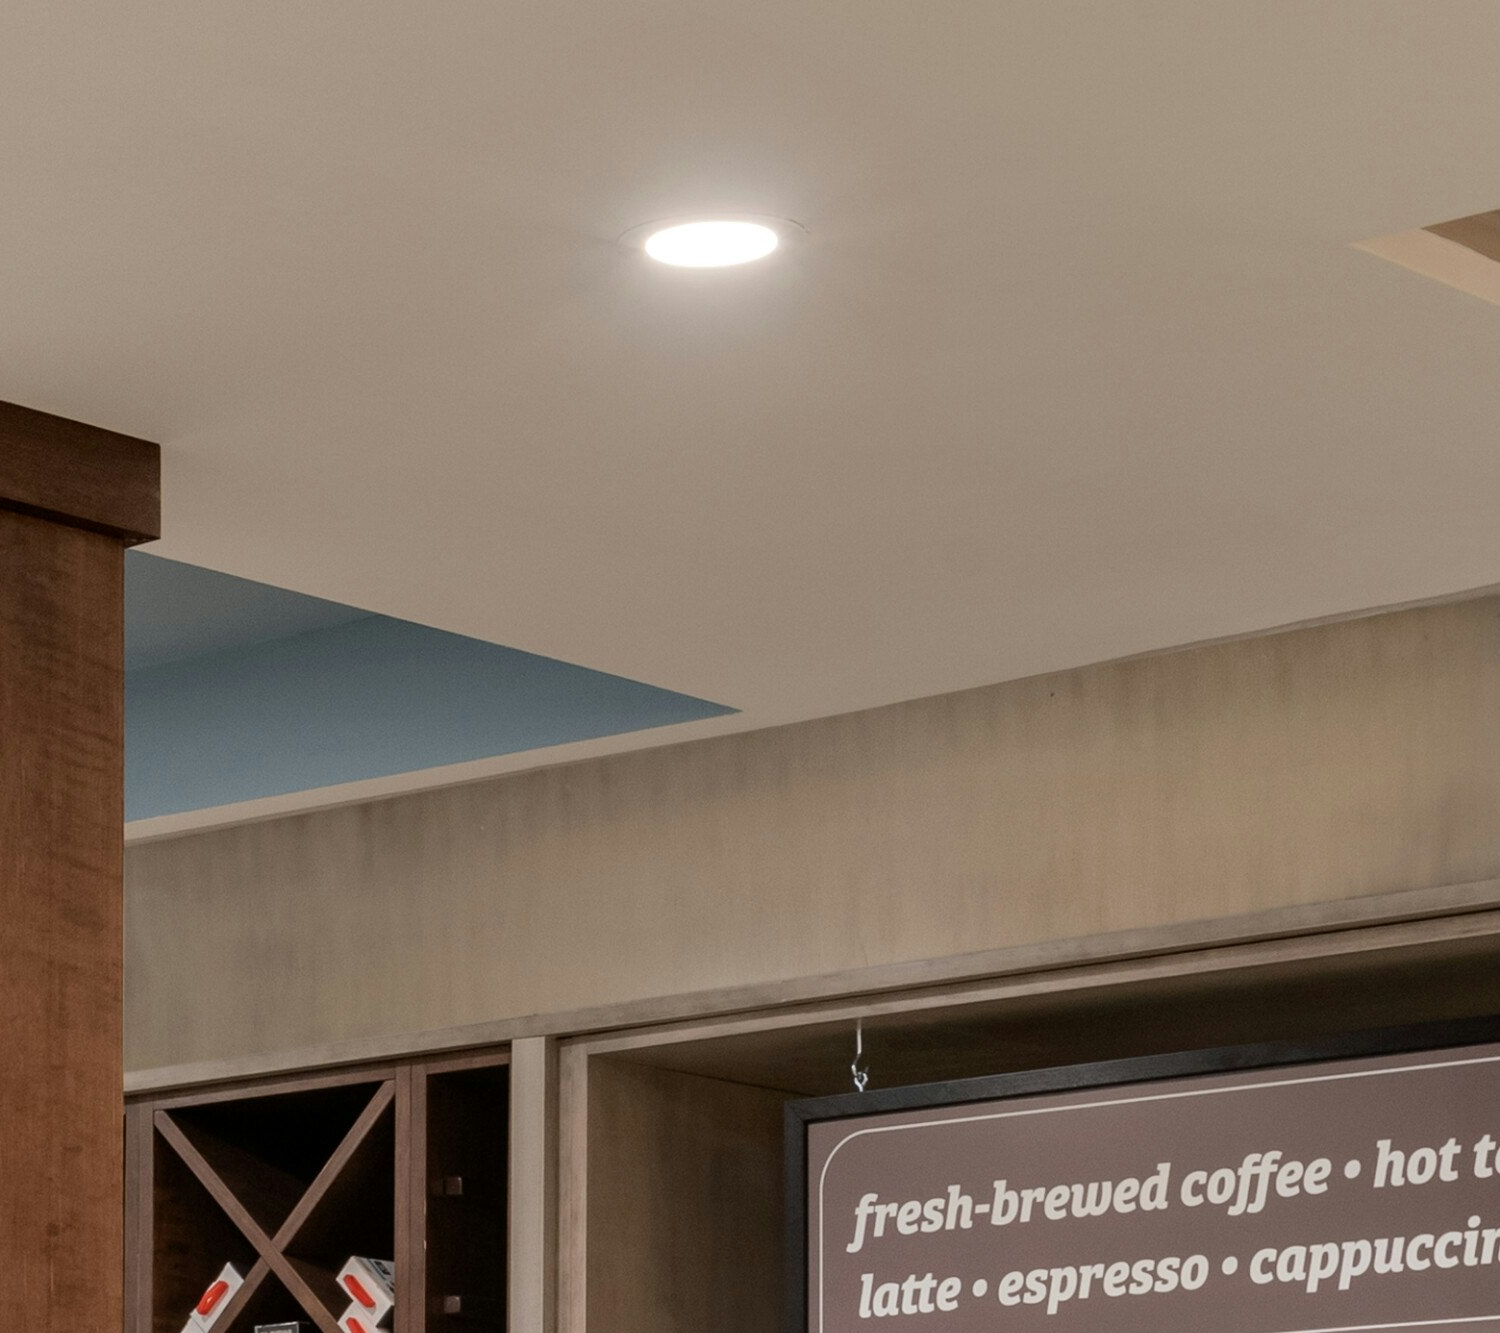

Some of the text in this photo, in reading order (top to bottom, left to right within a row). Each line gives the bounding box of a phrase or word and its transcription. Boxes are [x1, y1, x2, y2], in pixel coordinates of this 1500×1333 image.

[847, 1163, 1171, 1252] fresh-brewed
[1181, 1150, 1331, 1214] coffee
[1375, 1136, 1461, 1188] hot
[859, 1272, 961, 1319] latte
[998, 1252, 1209, 1314] espresso
